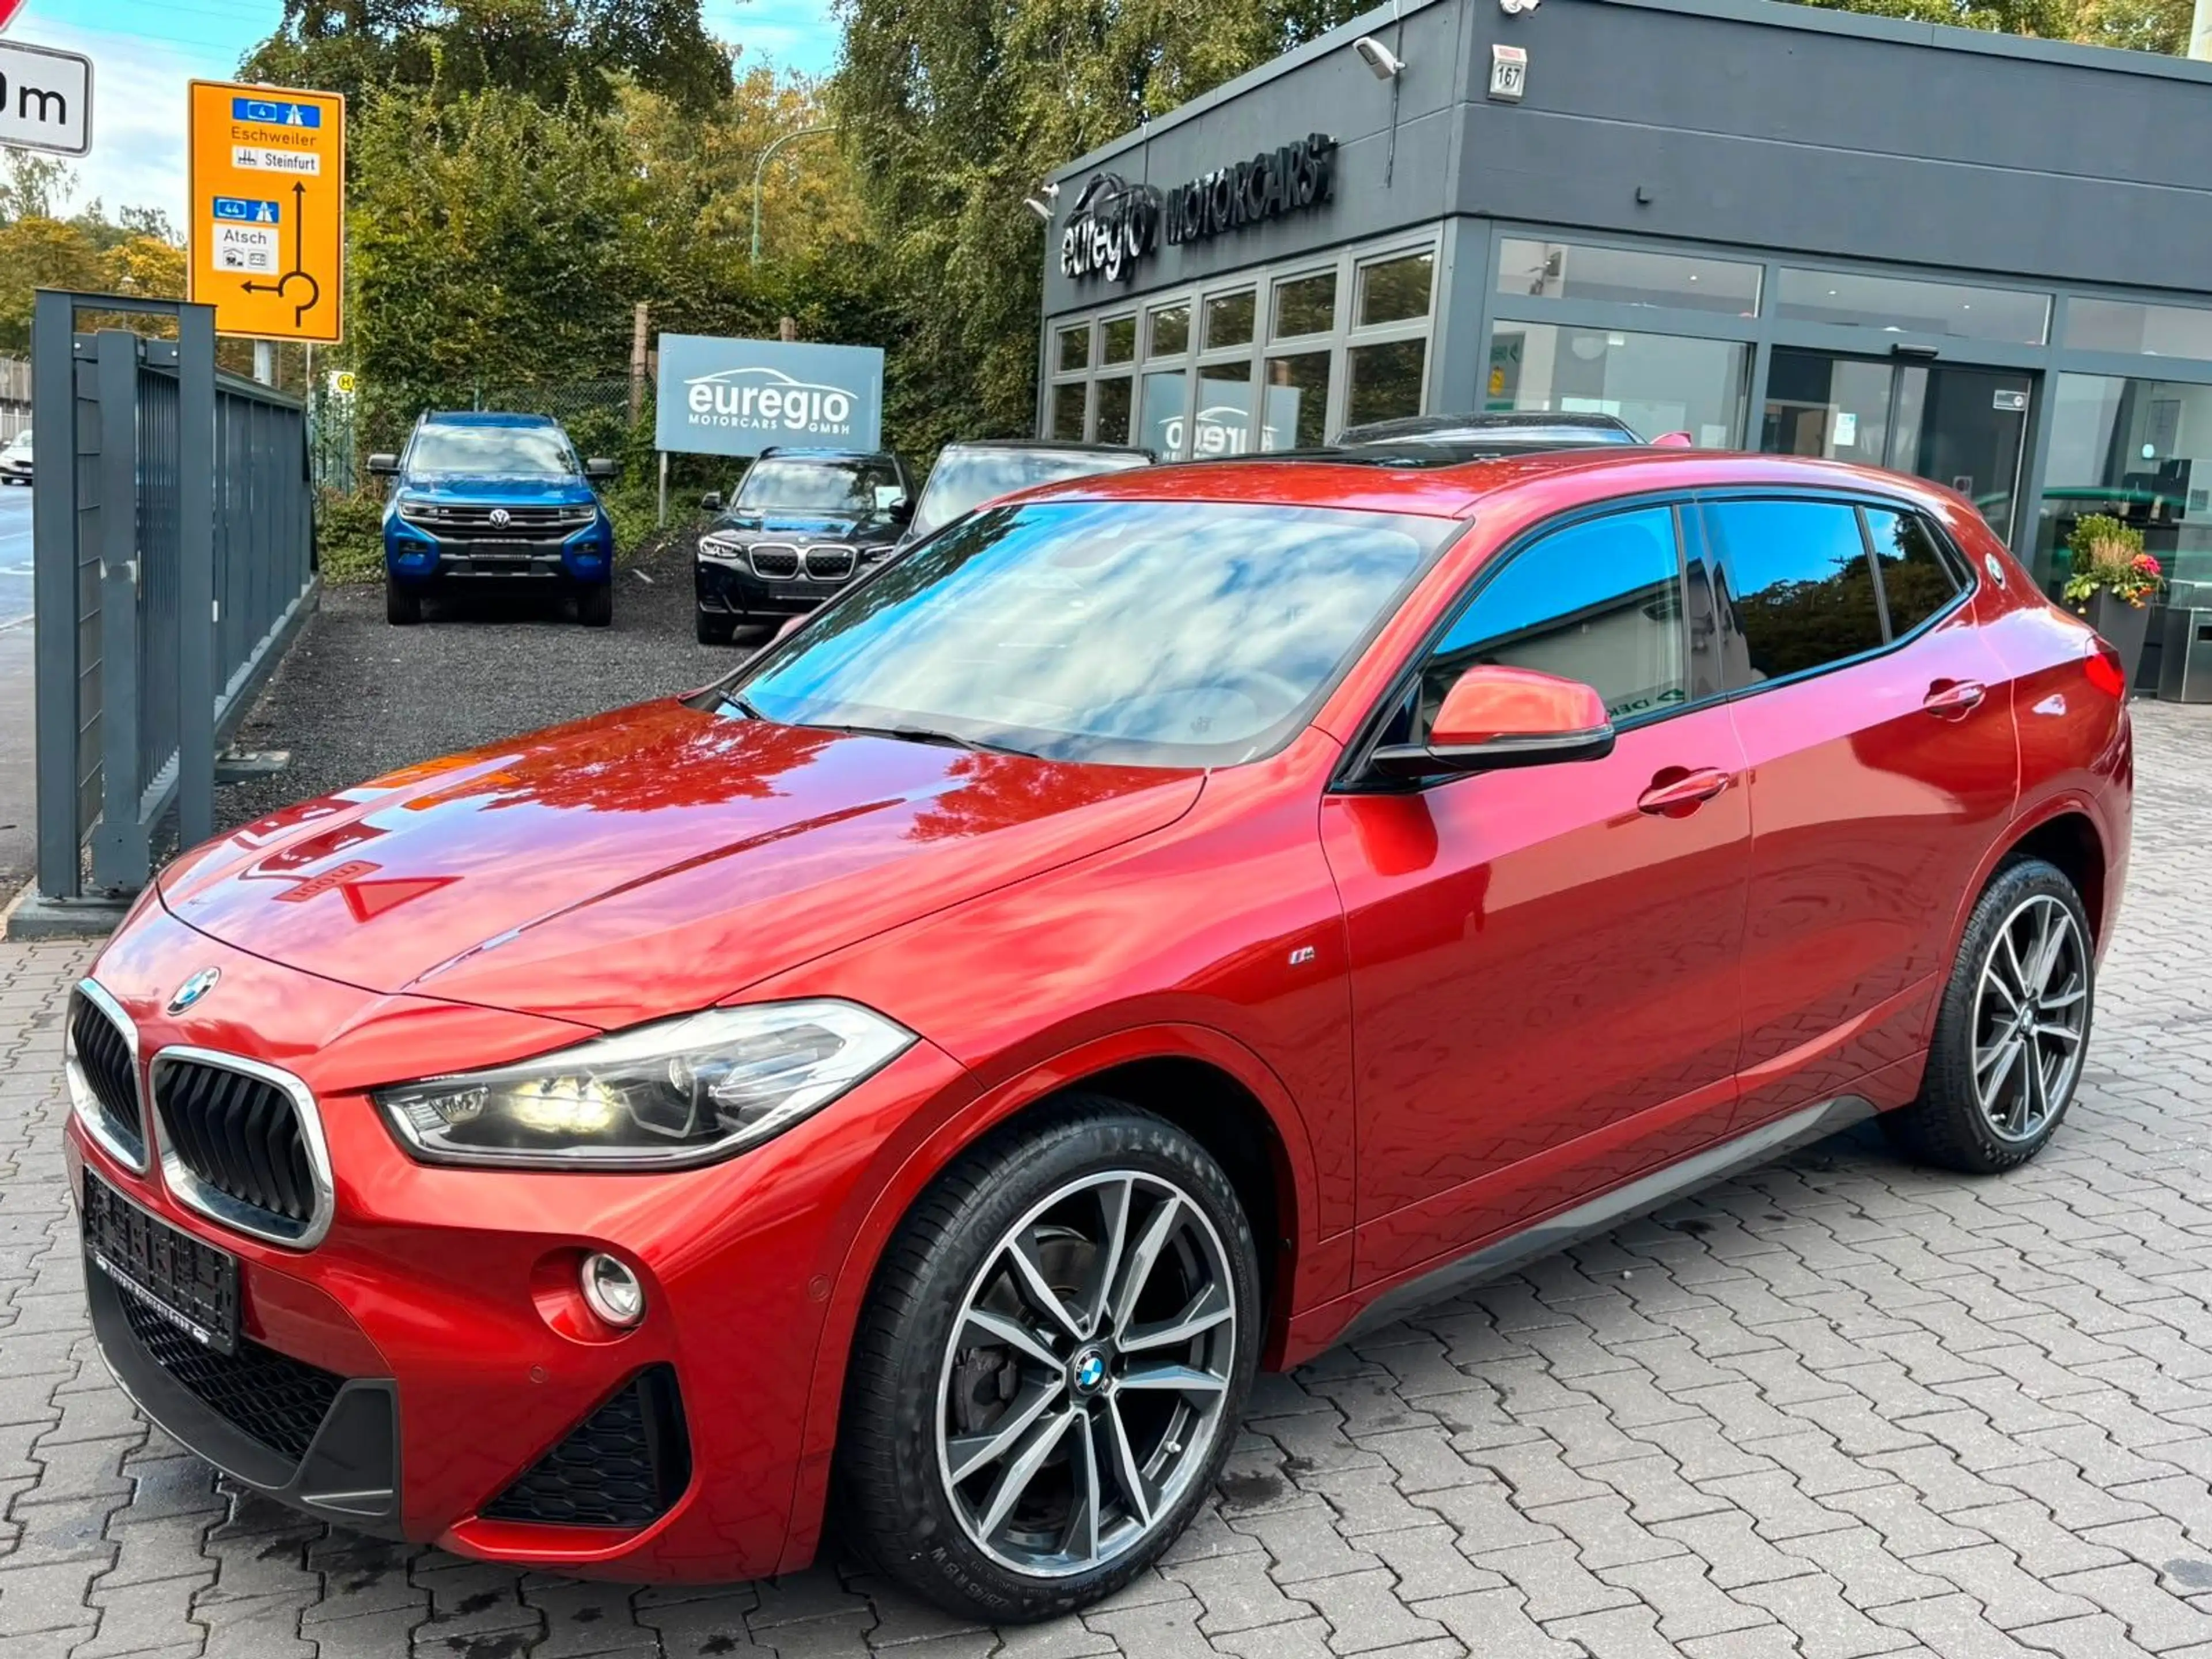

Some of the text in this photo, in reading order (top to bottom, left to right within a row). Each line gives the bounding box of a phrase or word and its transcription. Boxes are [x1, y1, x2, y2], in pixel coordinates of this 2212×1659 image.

[1498, 66, 1520, 86] 167
[258, 107, 266, 117] 4
[232, 126, 317, 146] Eschweiler
[265, 153, 315, 171] Steinfurt
[224, 203, 240, 214] 44
[1061, 132, 1330, 282] euregio MOTORCARS
[224, 229, 267, 245] Atsch
[688, 384, 849, 430] euregio
[688, 414, 850, 435] MOTORCARS GMBH
